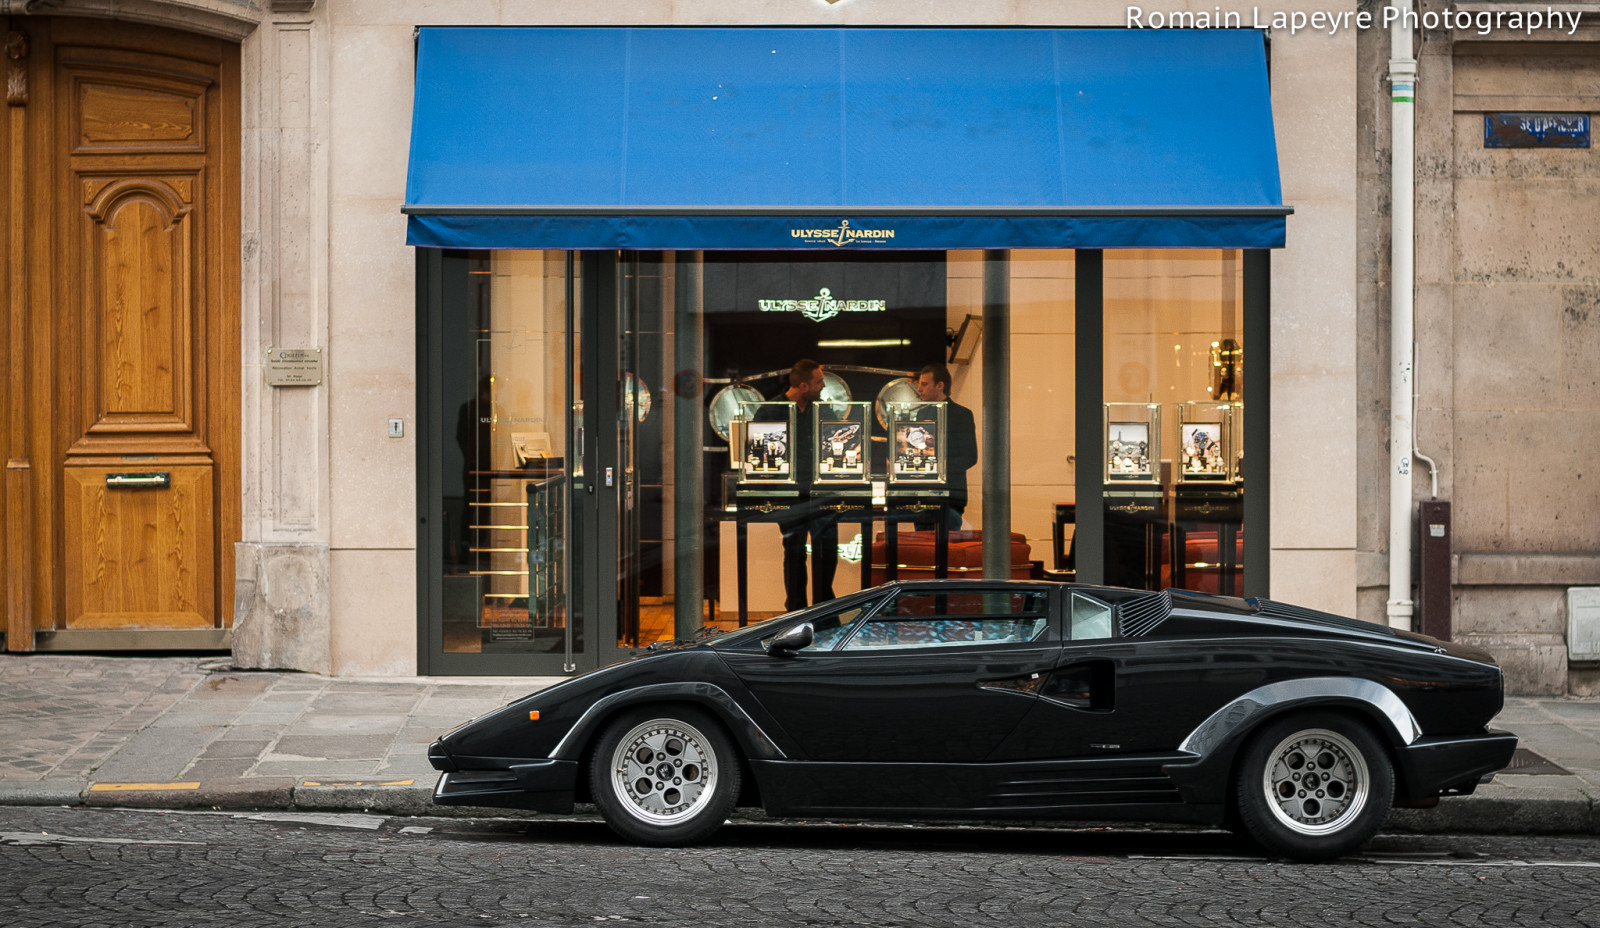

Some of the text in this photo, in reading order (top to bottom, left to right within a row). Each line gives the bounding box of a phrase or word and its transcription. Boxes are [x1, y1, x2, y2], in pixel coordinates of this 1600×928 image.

[791, 229, 895, 238] ULYSSE NARDIN
[758, 299, 886, 311] ULYSSE NARDIN
